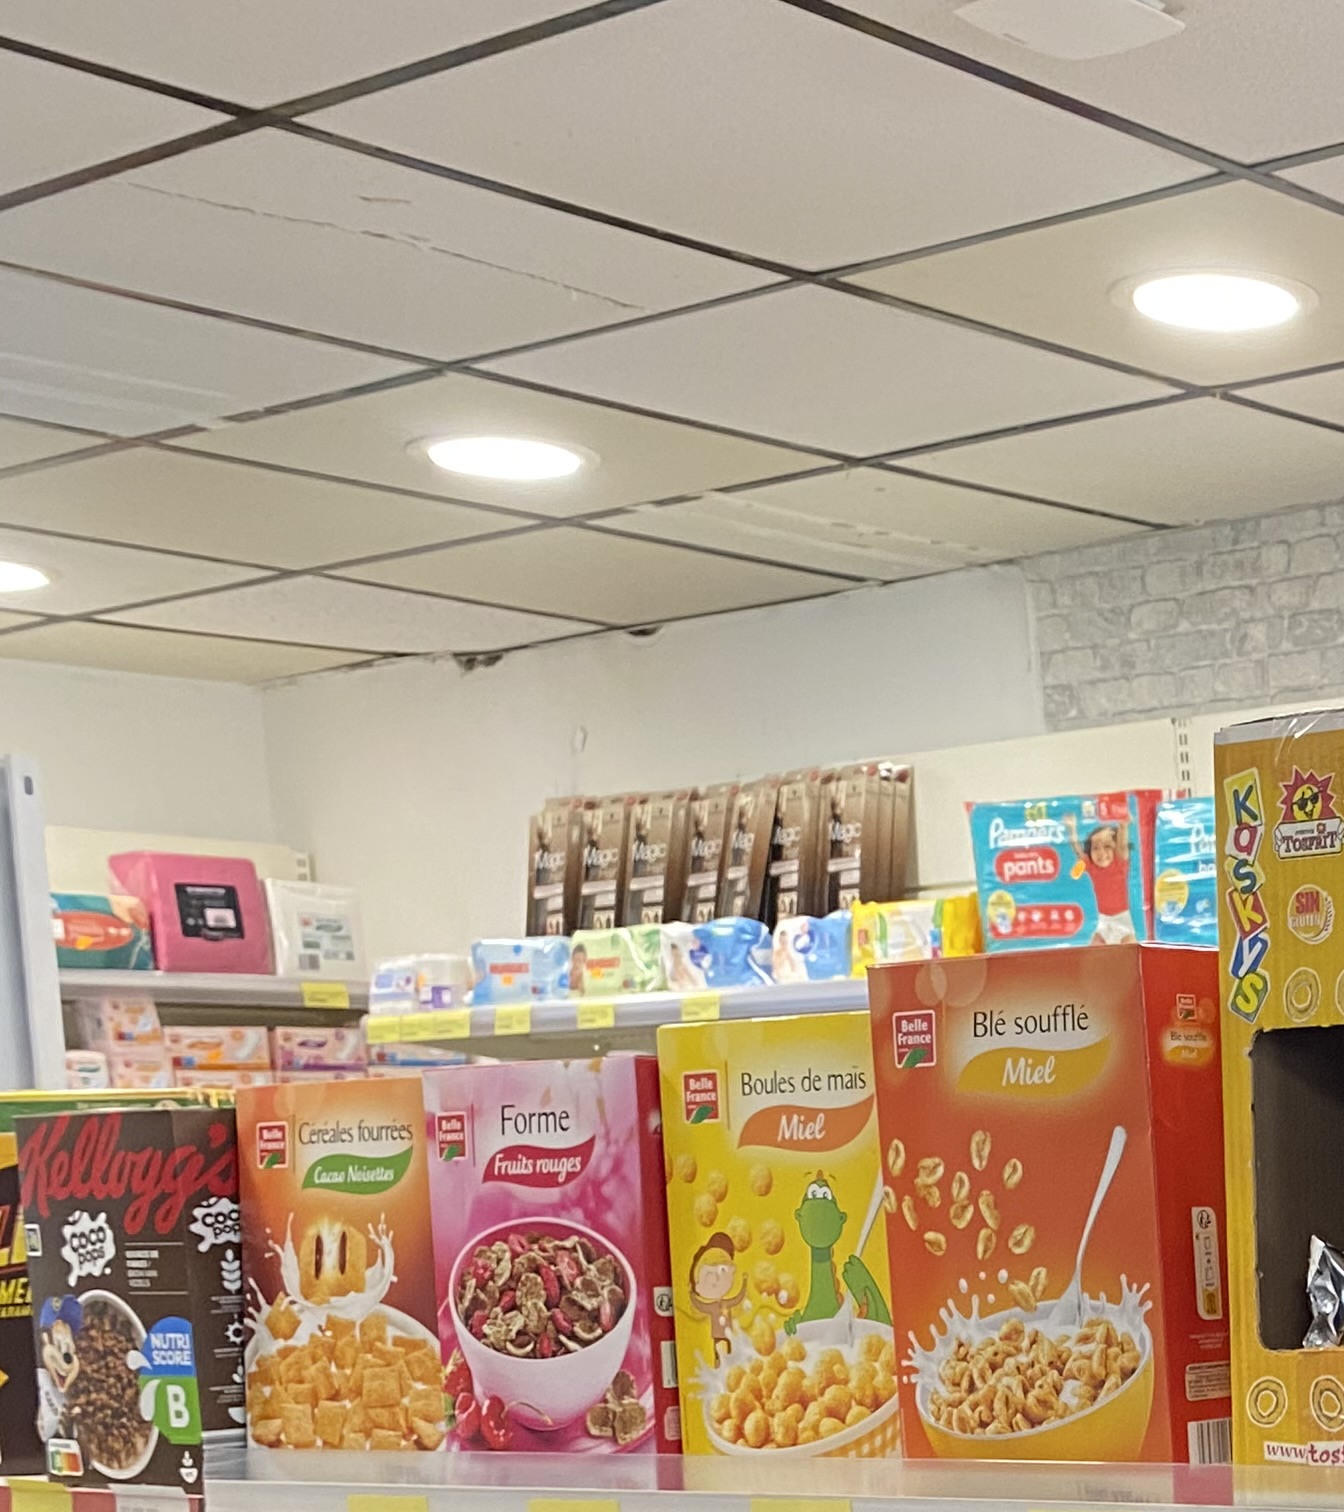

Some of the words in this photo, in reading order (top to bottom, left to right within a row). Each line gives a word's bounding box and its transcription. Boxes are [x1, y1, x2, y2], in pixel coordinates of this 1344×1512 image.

[1282, 830, 1336, 852] TOSFRIT
[1003, 856, 1055, 881] pants
[1296, 891, 1319, 913] SIN
[900, 1018, 929, 1034] Belle
[973, 1006, 1006, 1040] Blé
[1014, 1004, 1089, 1037] soufflé
[897, 1029, 932, 1047] France
[688, 1077, 712, 1090] Belle
[741, 1071, 795, 1098] Boules
[800, 1068, 822, 1094] de
[826, 1064, 867, 1091] maïs
[1002, 1056, 1055, 1087] Miel
[299, 1120, 354, 1146] Céréales
[358, 1119, 413, 1141] fourrées
[501, 1104, 570, 1136] Forme
[777, 1115, 826, 1140] Miel
[18, 1113, 240, 1234] Kellogg's
[314, 1167, 345, 1183] Cacao
[494, 1154, 533, 1175] Fruits
[536, 1153, 582, 1182] rouges
[150, 1333, 190, 1351] NUTRI
[152, 1351, 191, 1365] SCORE
[167, 1385, 190, 1429] B
